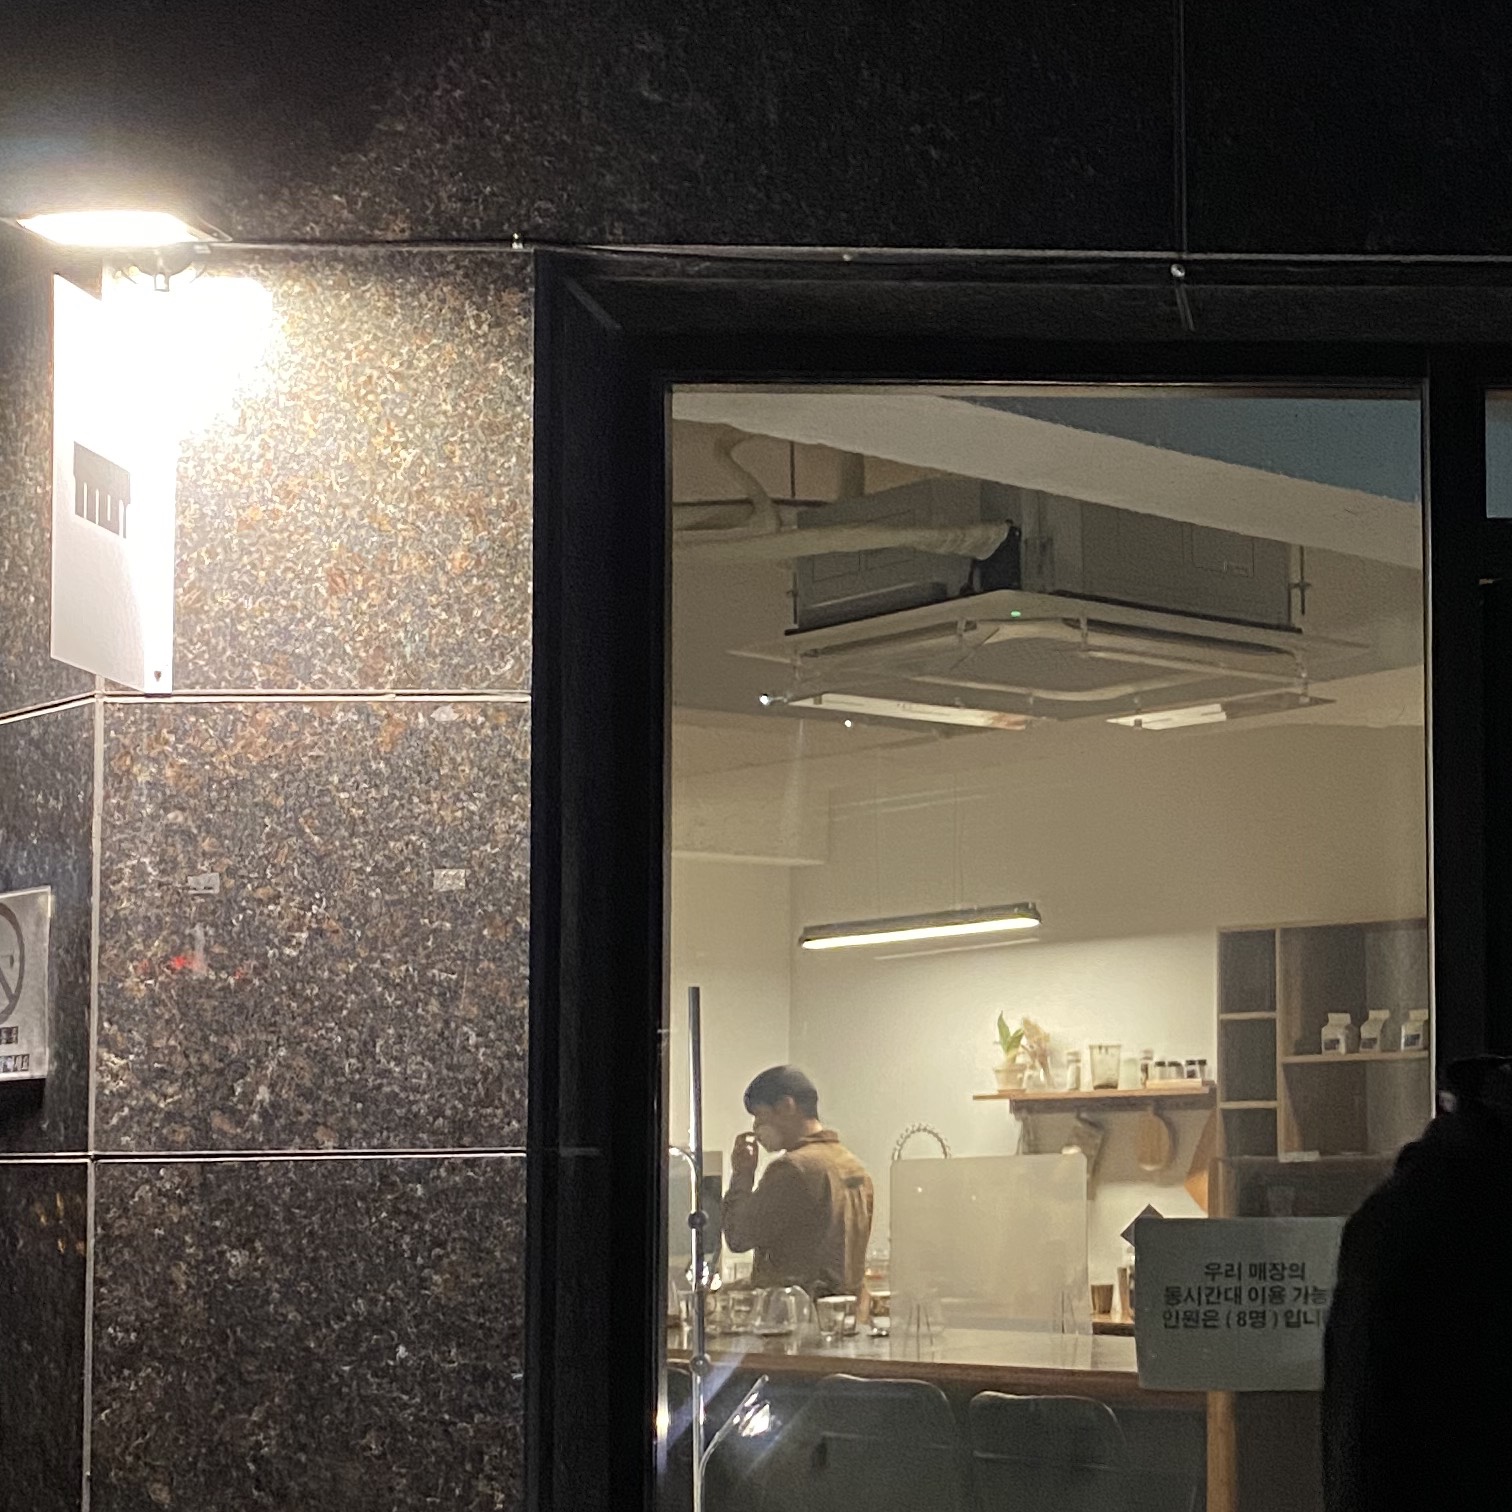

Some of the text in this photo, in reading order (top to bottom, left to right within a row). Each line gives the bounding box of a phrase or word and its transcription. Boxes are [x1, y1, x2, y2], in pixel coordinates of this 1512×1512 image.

[1203, 1261, 1306, 1282] 우리 매장의
[1163, 1285, 1242, 1307] 동시간대
[1247, 1285, 1286, 1306] 이용
[1162, 1309, 1220, 1329] 인원은
